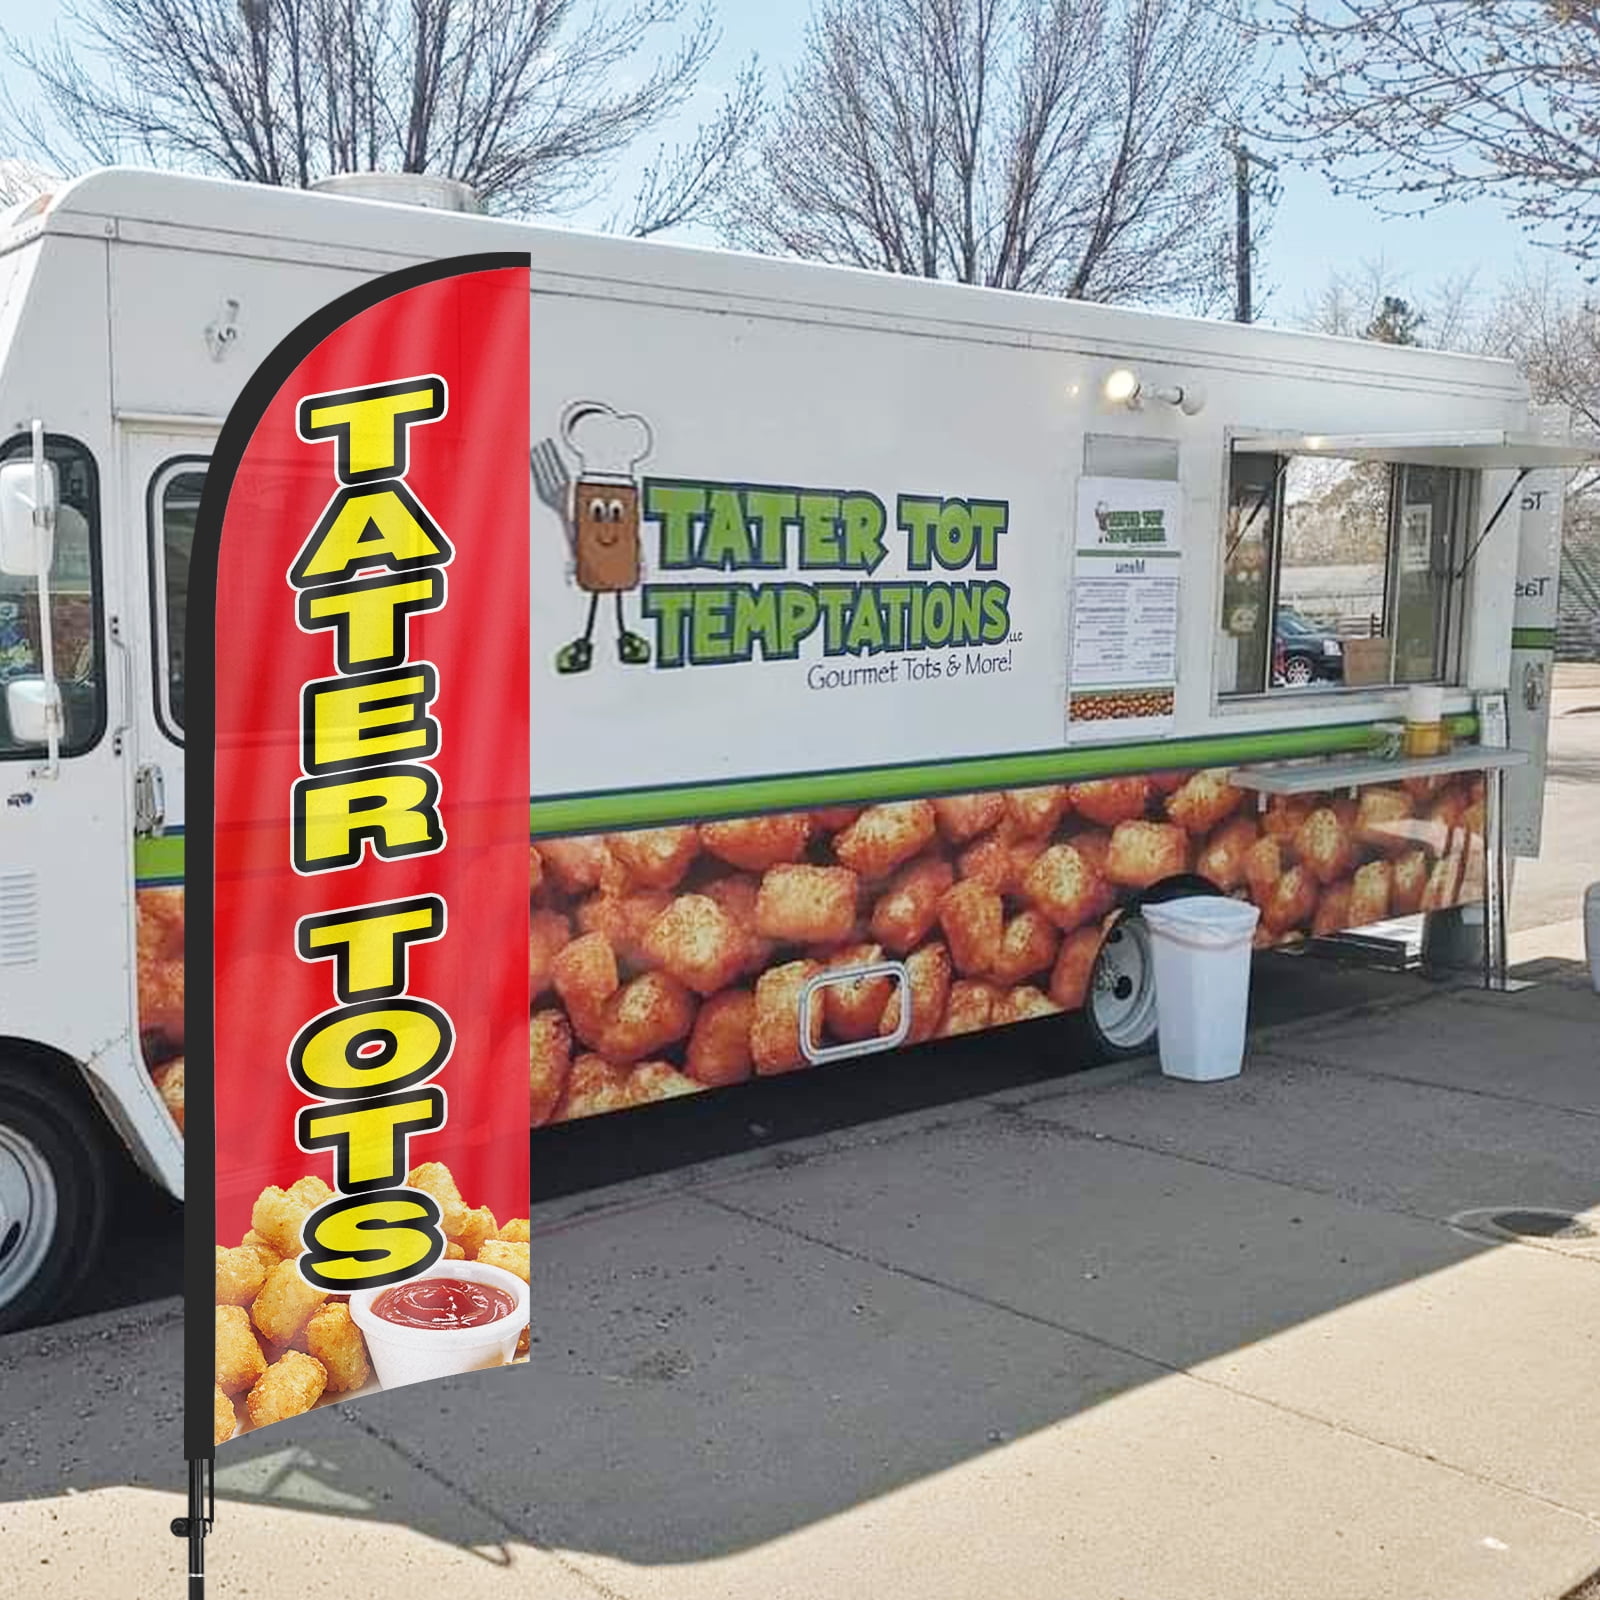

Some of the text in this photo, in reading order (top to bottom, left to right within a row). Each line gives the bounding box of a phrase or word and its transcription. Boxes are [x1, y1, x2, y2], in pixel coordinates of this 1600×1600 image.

[642, 476, 1009, 575] TATER TOT
[642, 580, 1011, 669] TEMPTATIONS
[807, 649, 1012, 690] Gourmet Tots & More!
[286, 374, 455, 1291] TATER TOTS
